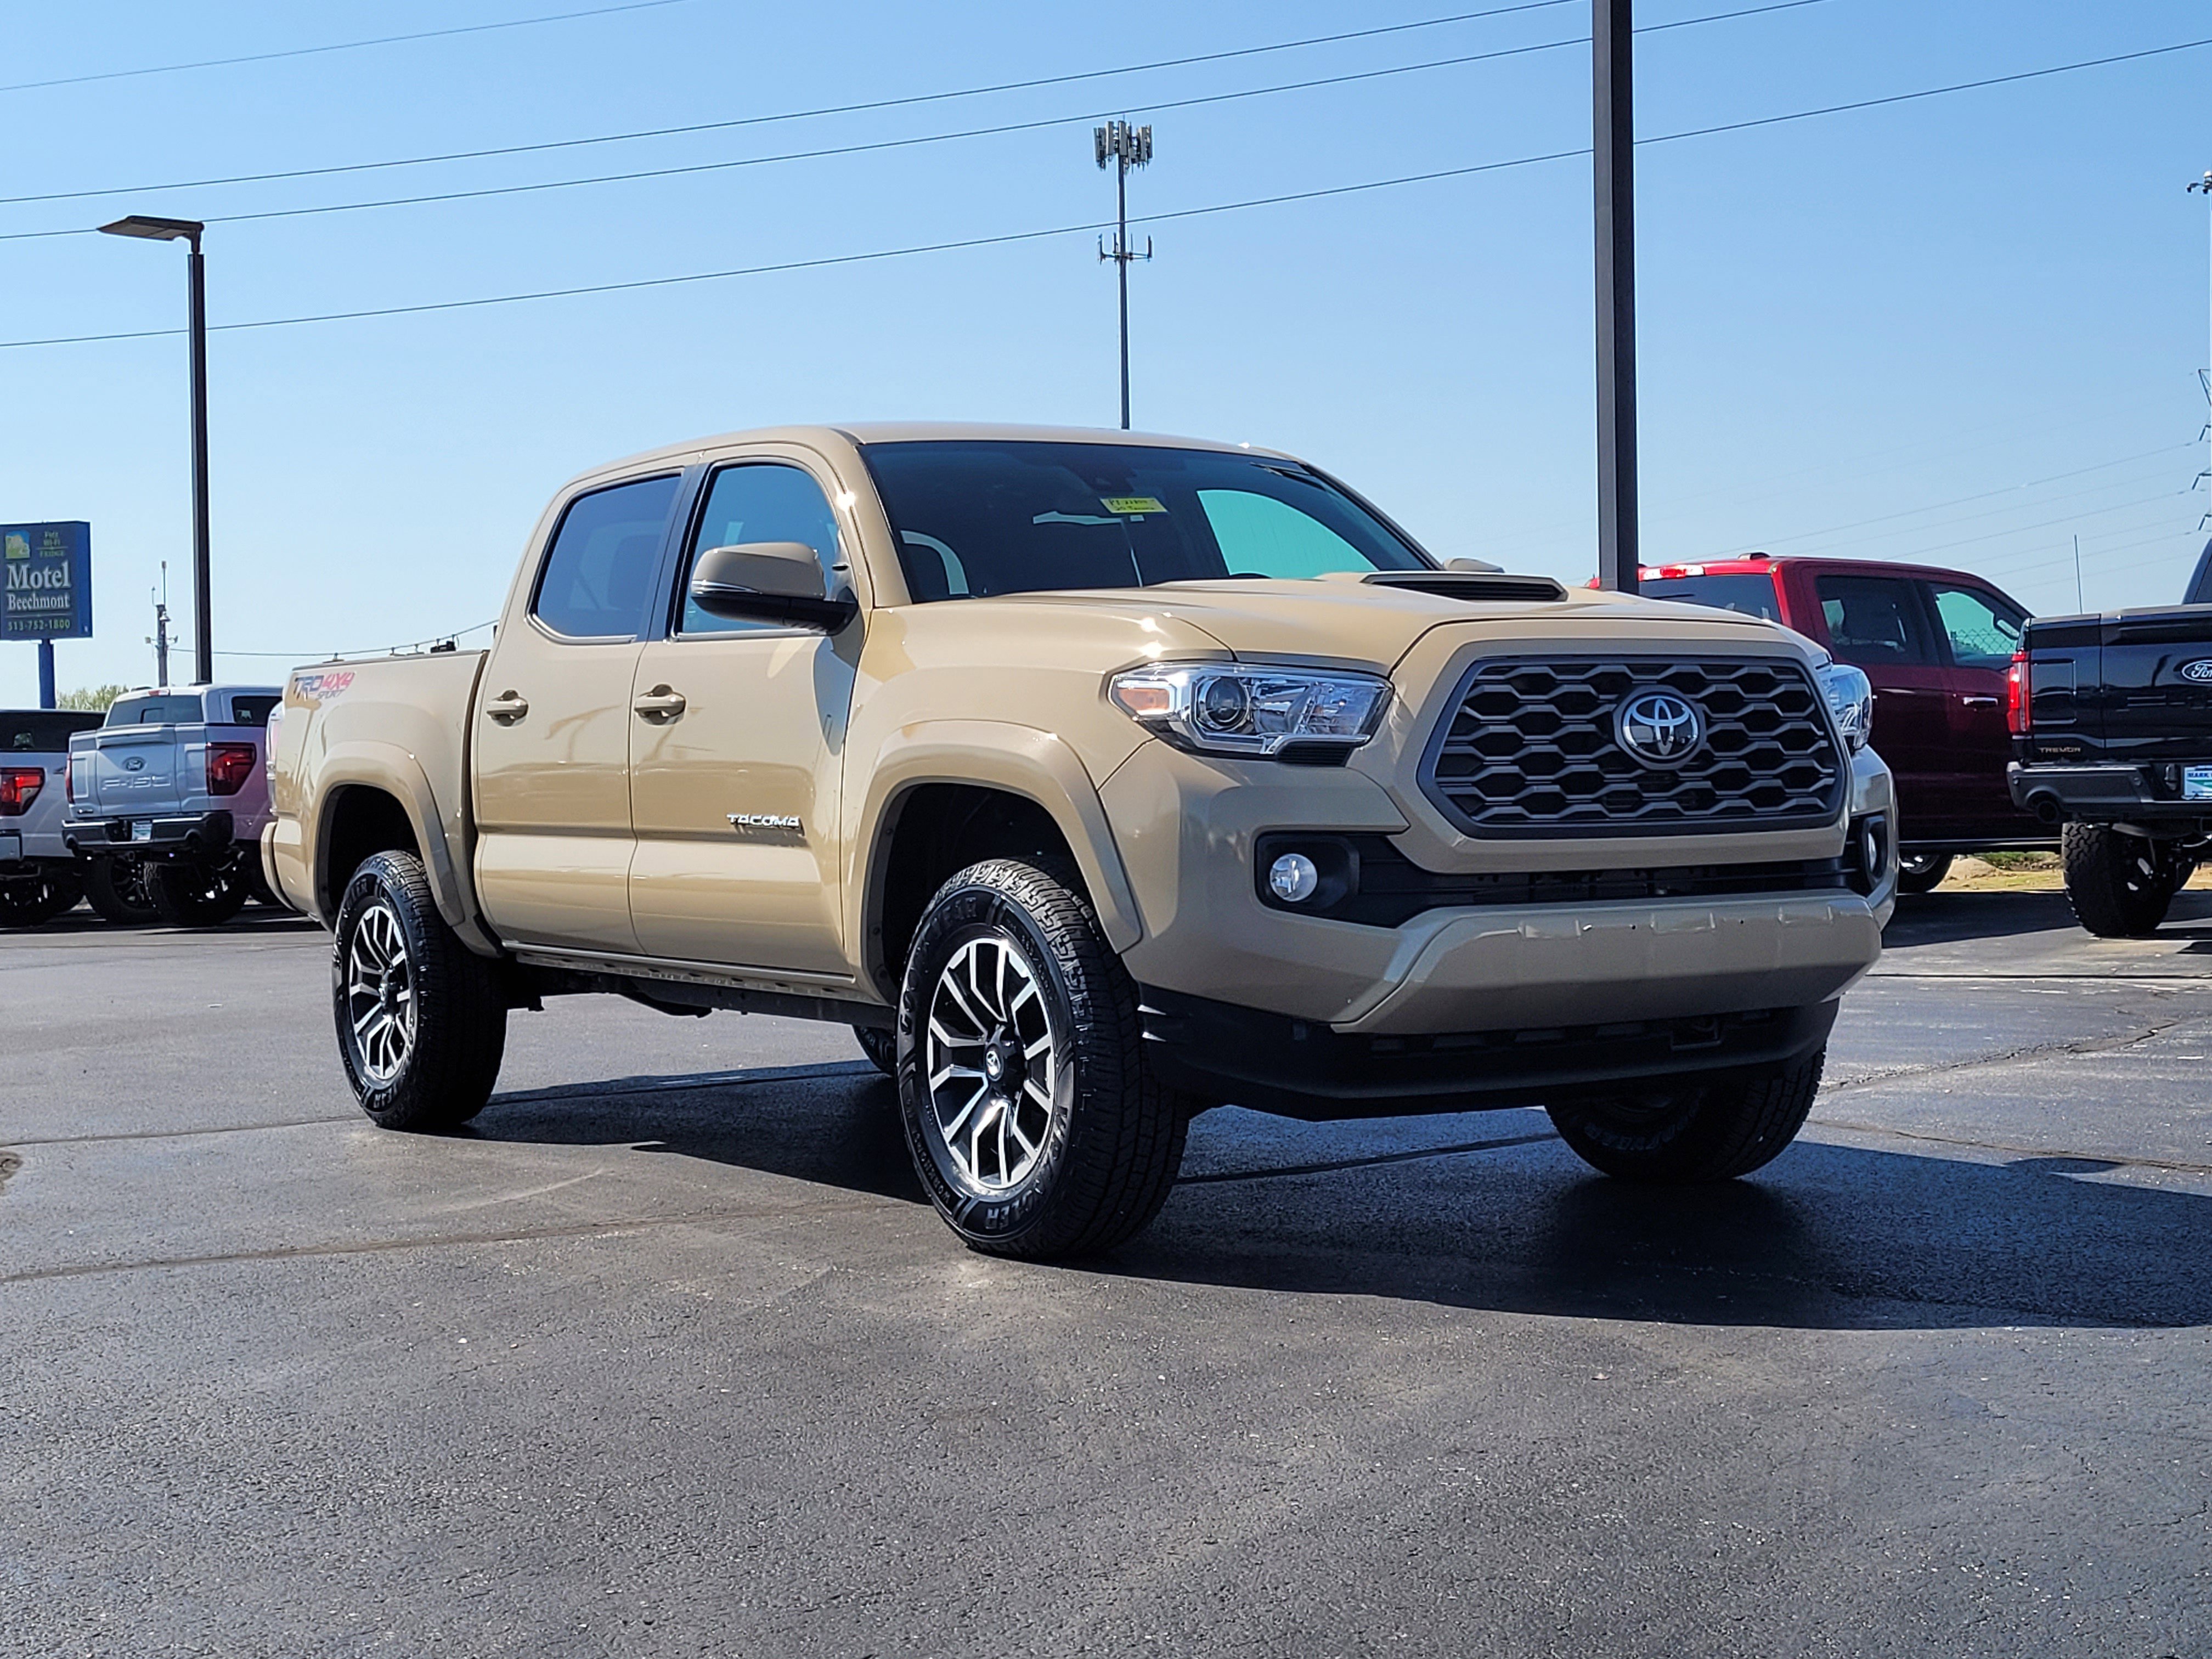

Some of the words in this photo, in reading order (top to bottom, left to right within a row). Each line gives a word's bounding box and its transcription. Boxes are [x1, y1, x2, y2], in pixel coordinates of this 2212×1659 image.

[7, 559, 71, 590] Motel
[7, 592, 70, 611] Beechmont
[293, 675, 324, 700] TRD
[101, 775, 171, 791] F-150
[726, 814, 800, 826] TACOMA
